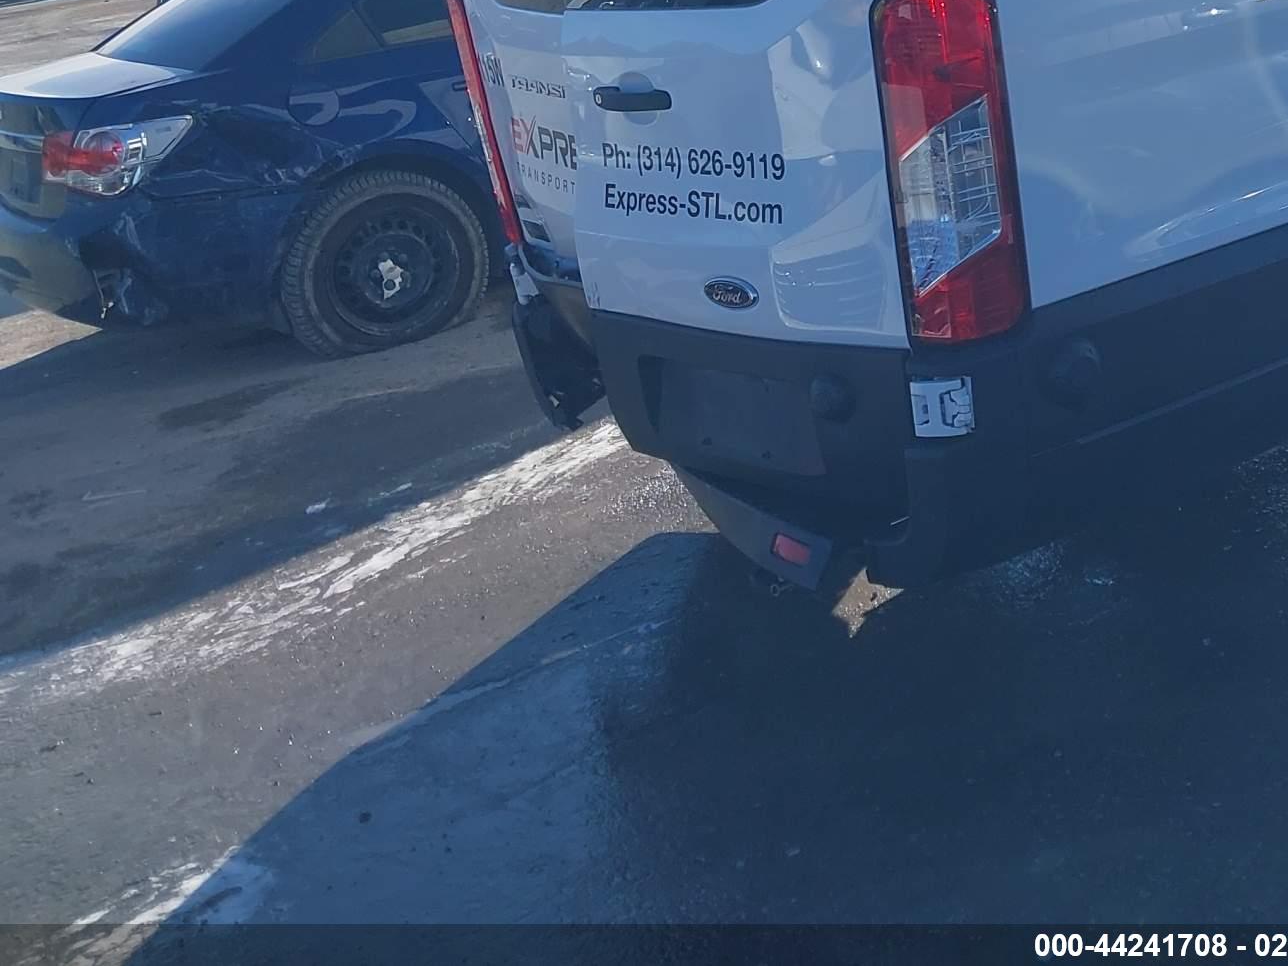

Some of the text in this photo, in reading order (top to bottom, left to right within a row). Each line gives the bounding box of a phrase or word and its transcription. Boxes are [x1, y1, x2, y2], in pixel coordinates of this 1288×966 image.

[602, 143, 785, 180] Ph: (314) 626-9119
[604, 183, 783, 224] Express-STL.com
